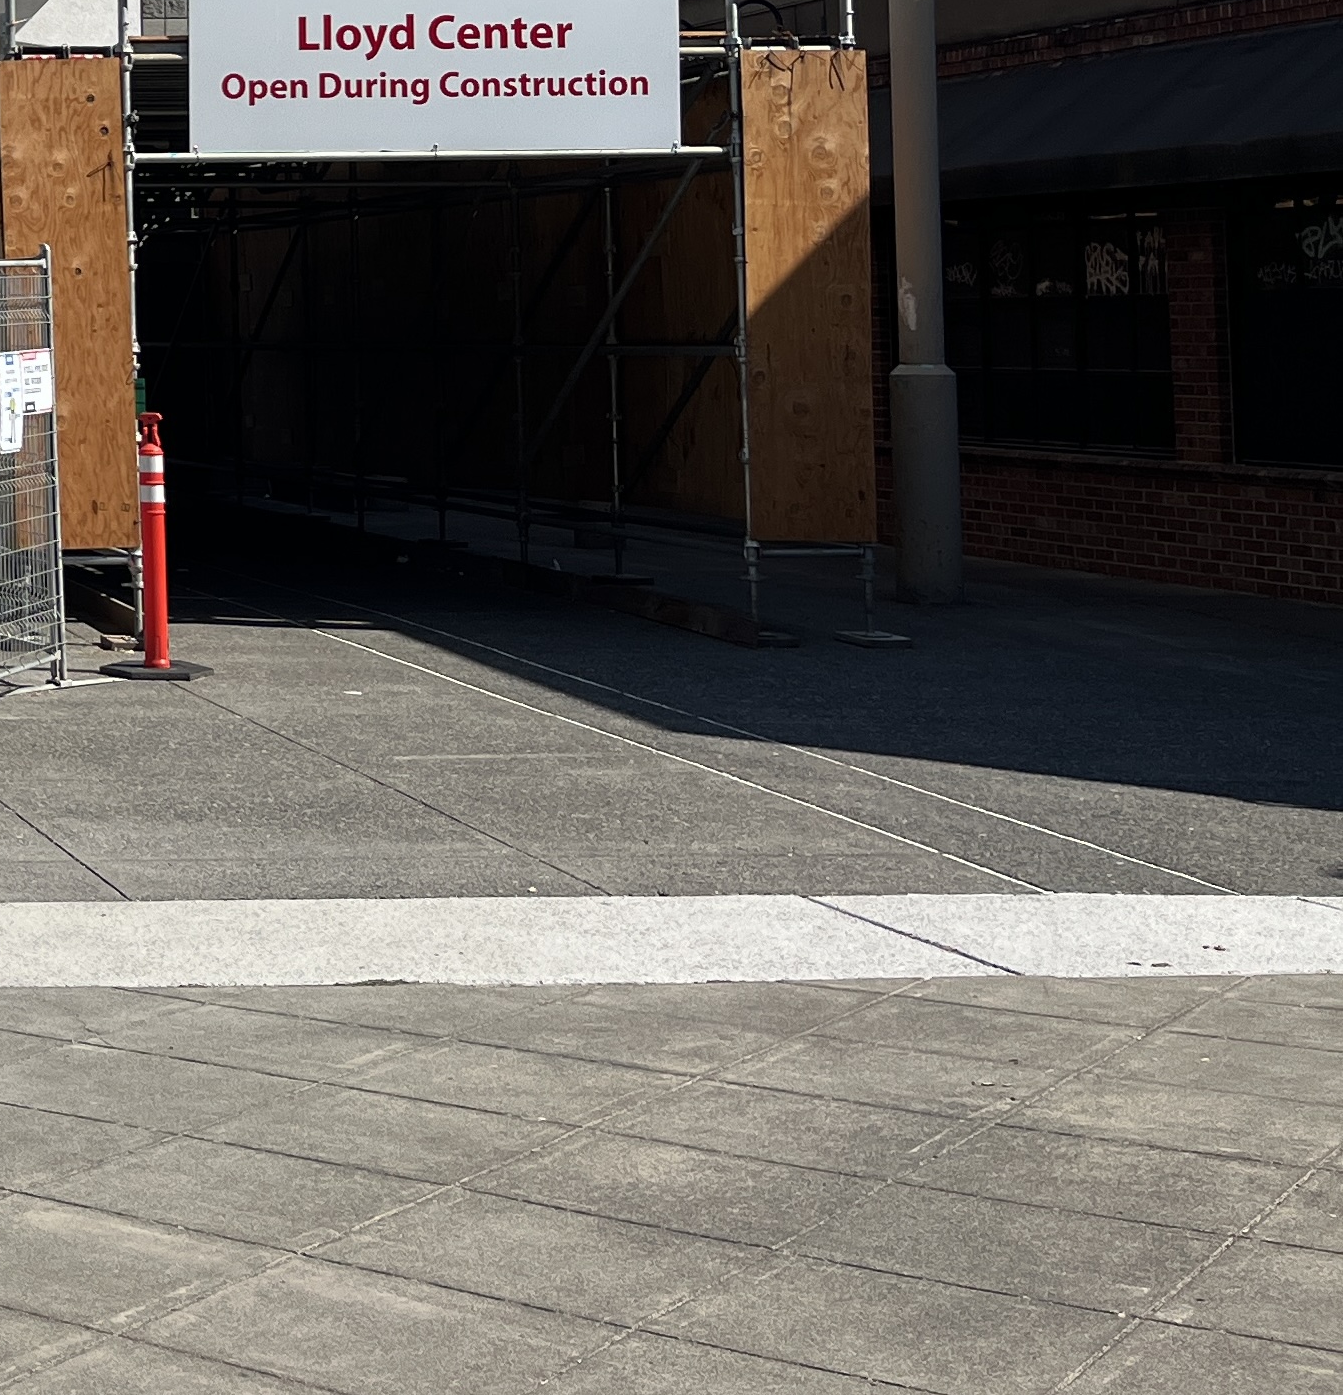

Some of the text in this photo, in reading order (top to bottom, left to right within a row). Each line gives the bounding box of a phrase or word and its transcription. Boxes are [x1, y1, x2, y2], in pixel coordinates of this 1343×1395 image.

[298, 14, 572, 60] Lloyd Center
[222, 72, 649, 105] Open During Construction
